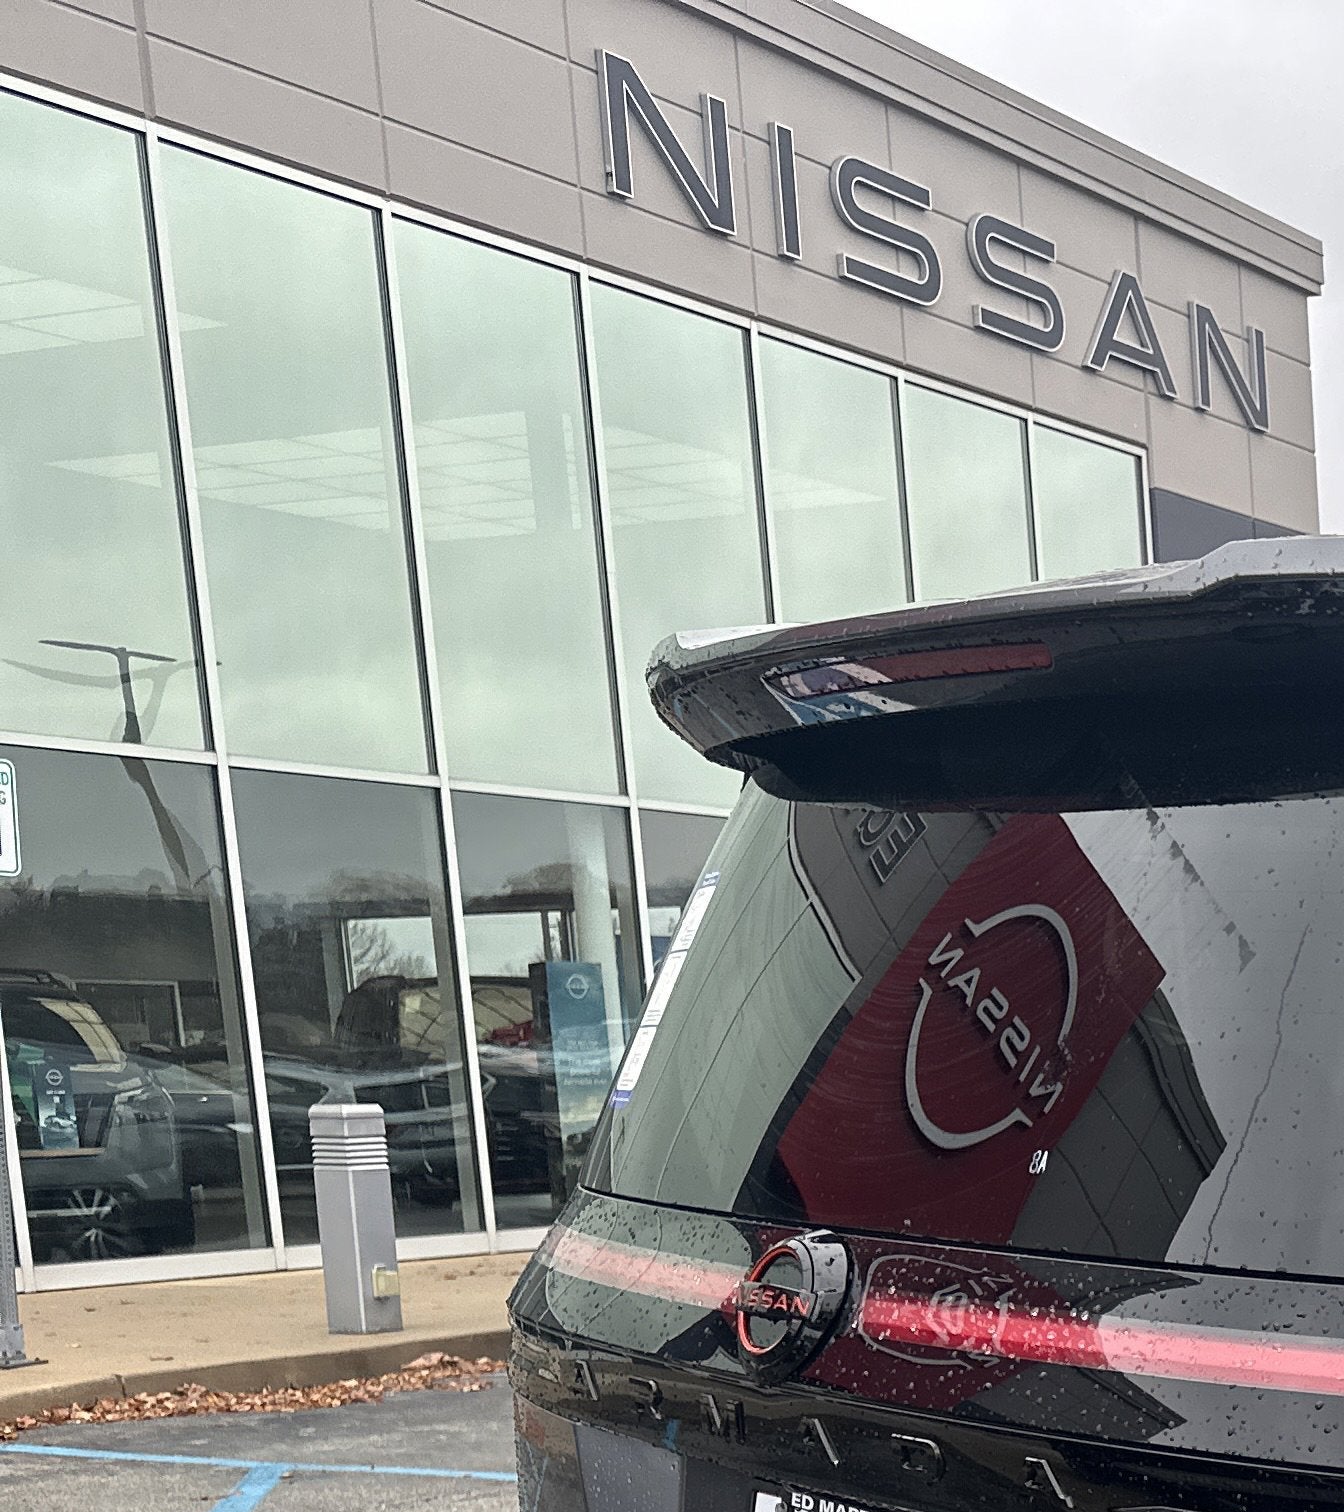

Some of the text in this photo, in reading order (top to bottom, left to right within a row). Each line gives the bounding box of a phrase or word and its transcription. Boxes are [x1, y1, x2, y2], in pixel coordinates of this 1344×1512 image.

[596, 49, 1269, 433] NISSAN
[735, 1284, 811, 1317] SSAN
[563, 1360, 1075, 1509] ARMADA
[791, 1492, 814, 1511] ED
